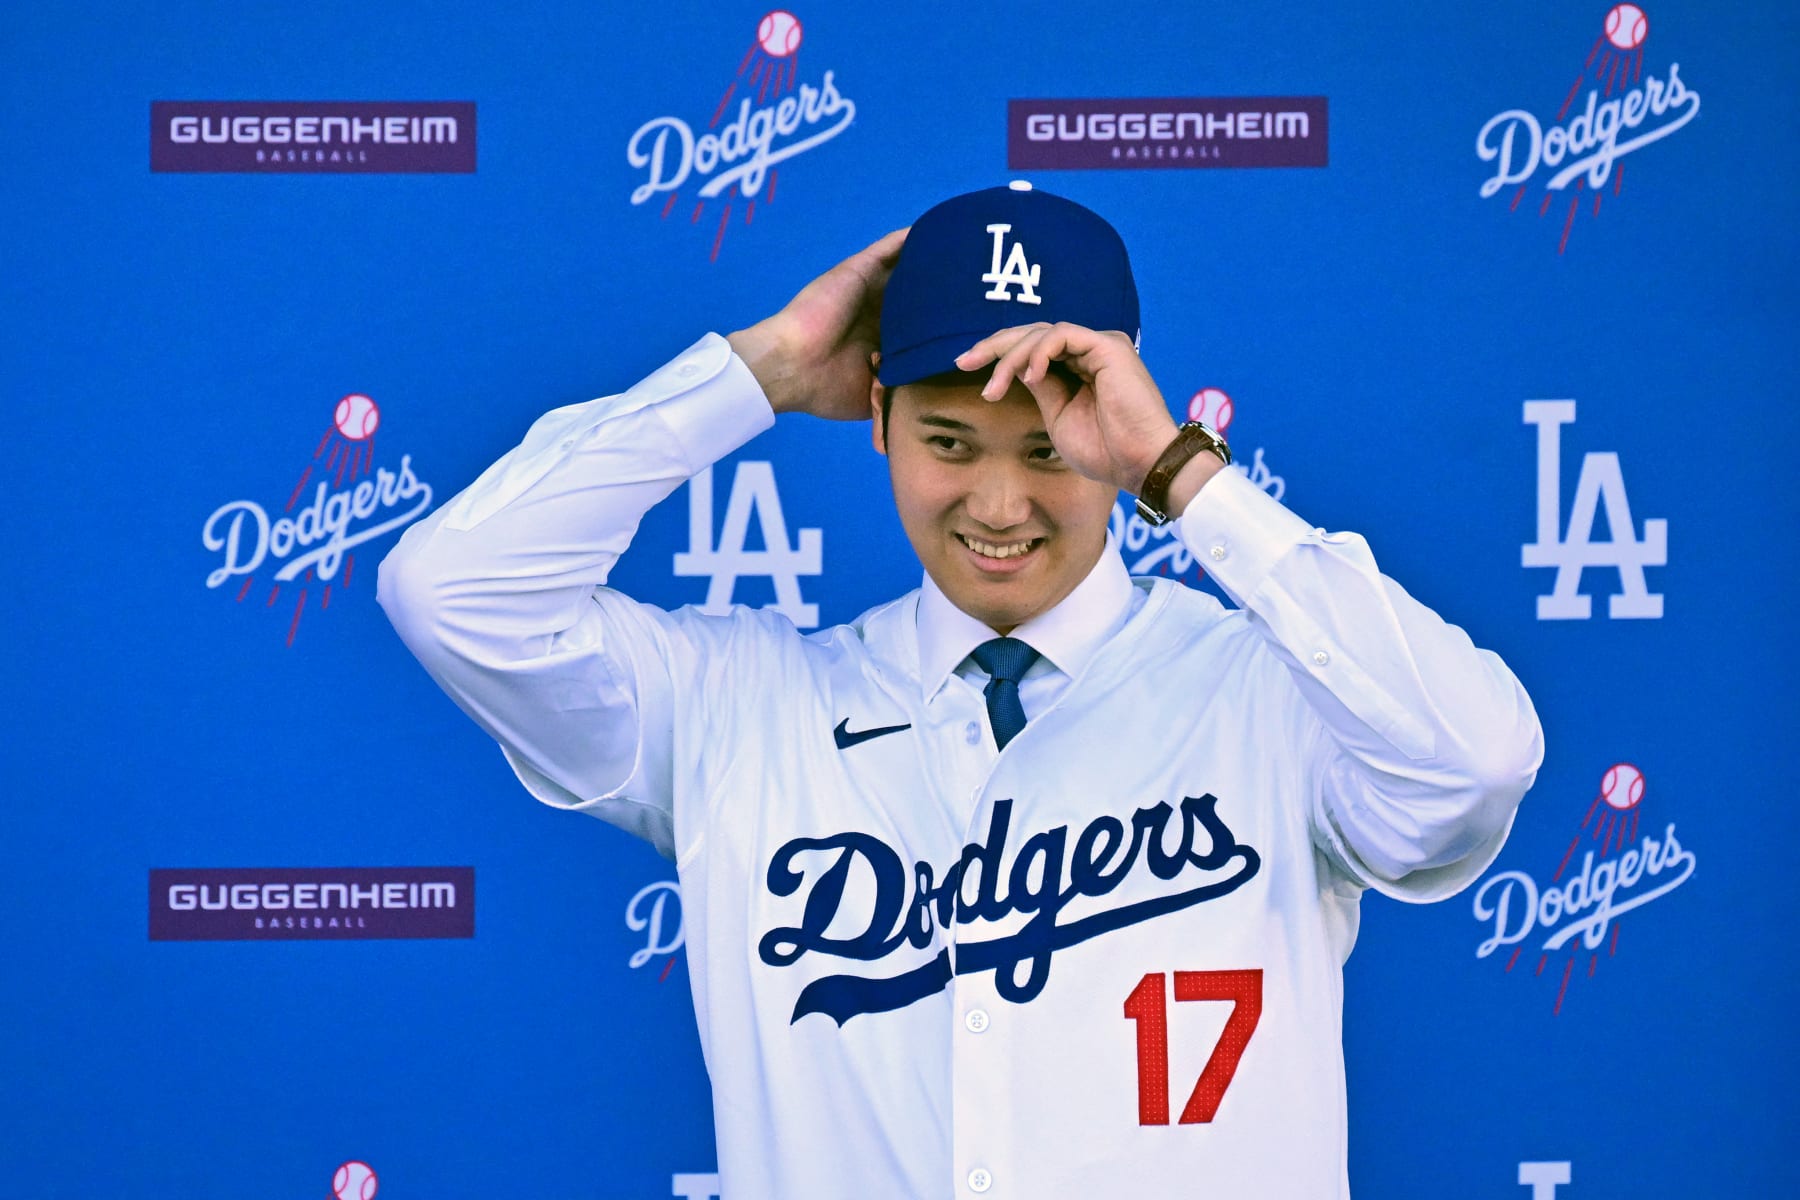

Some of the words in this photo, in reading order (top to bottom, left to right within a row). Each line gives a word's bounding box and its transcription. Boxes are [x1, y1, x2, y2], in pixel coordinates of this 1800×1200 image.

[169, 116, 458, 143] GUGGENHEIM
[255, 150, 368, 163] BASEBALL
[628, 70, 856, 205] Dodgers
[1026, 111, 1310, 141] GUGGENHEIM
[1111, 145, 1221, 159] BASEBALL
[1476, 63, 1701, 198] Dodgers
[981, 223, 1042, 305] LA
[202, 454, 433, 590] Dodgers
[1521, 400, 1667, 620] LA
[168, 881, 456, 911] GUGGENHEIM
[254, 916, 367, 930] BASEBALL
[758, 793, 1261, 1028] Dodgers
[1473, 823, 1697, 959] Dodgers
[1123, 968, 1264, 1126] 17
